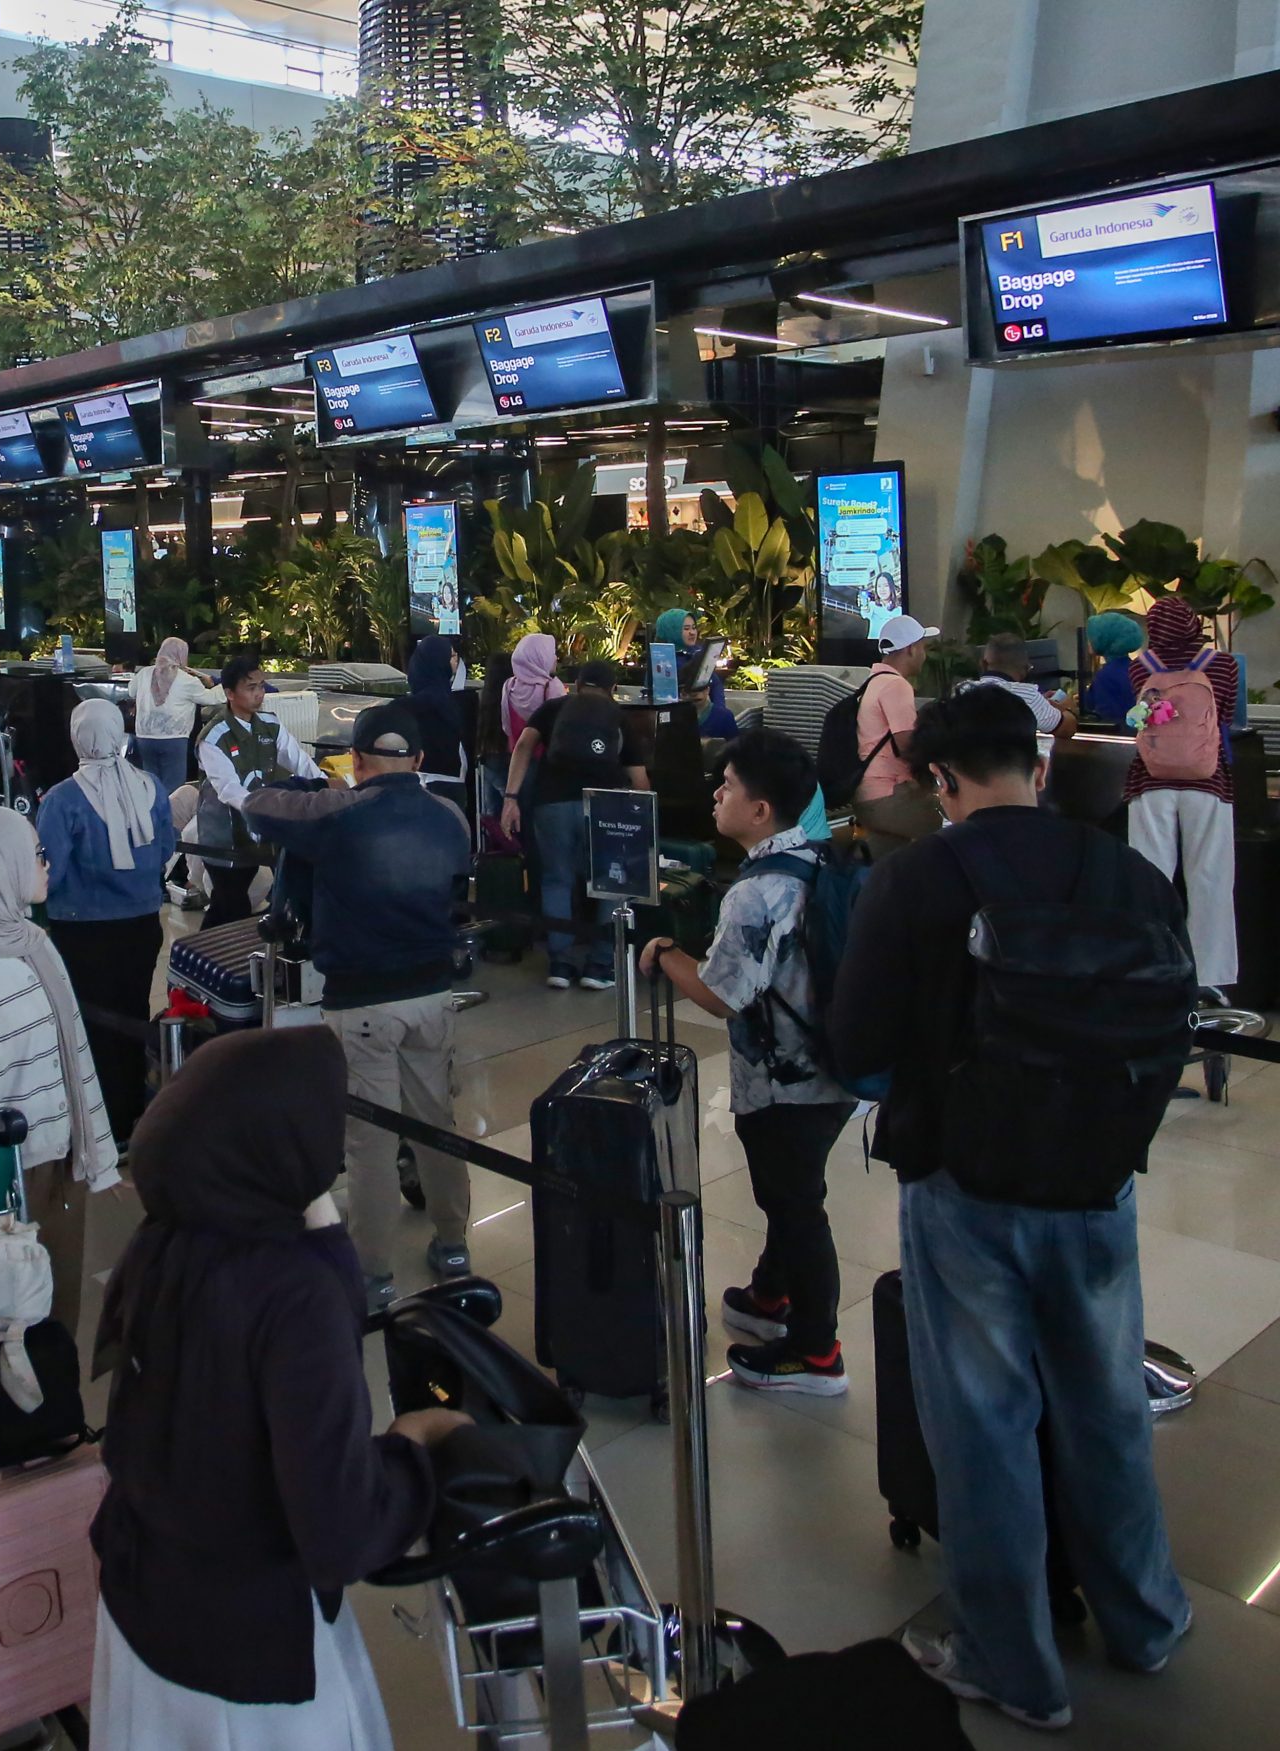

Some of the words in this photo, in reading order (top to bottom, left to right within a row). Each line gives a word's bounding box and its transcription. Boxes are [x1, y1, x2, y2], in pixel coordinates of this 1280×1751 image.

[1049, 226, 1092, 243] Garuda
[1095, 217, 1154, 235] Indonesia
[1000, 231, 1024, 252] F1
[998, 269, 1075, 292] Baggage
[1000, 293, 1044, 310] Drop
[484, 328, 502, 343] F2
[515, 326, 539, 337] Garuda
[540, 320, 574, 333] Indonesia
[1023, 324, 1044, 338] LG
[316, 359, 332, 373] F3
[341, 359, 362, 368] Garuda
[362, 353, 389, 365] Indonesia
[490, 356, 535, 372] Baggage
[494, 373, 519, 385] Drop
[323, 384, 360, 398] Baggage
[328, 399, 349, 410] Drop
[510, 395, 523, 406] LG
[64, 411, 74, 422] F4
[342, 418, 354, 427] LG
[69, 432, 94, 443] Baggage
[73, 443, 88, 453] Drop
[839, 507, 875, 515] Jamkrindo
[598, 820, 616, 829] Excess
[617, 822, 641, 832] Baggage
[775, 1362, 805, 1374] HOKA
